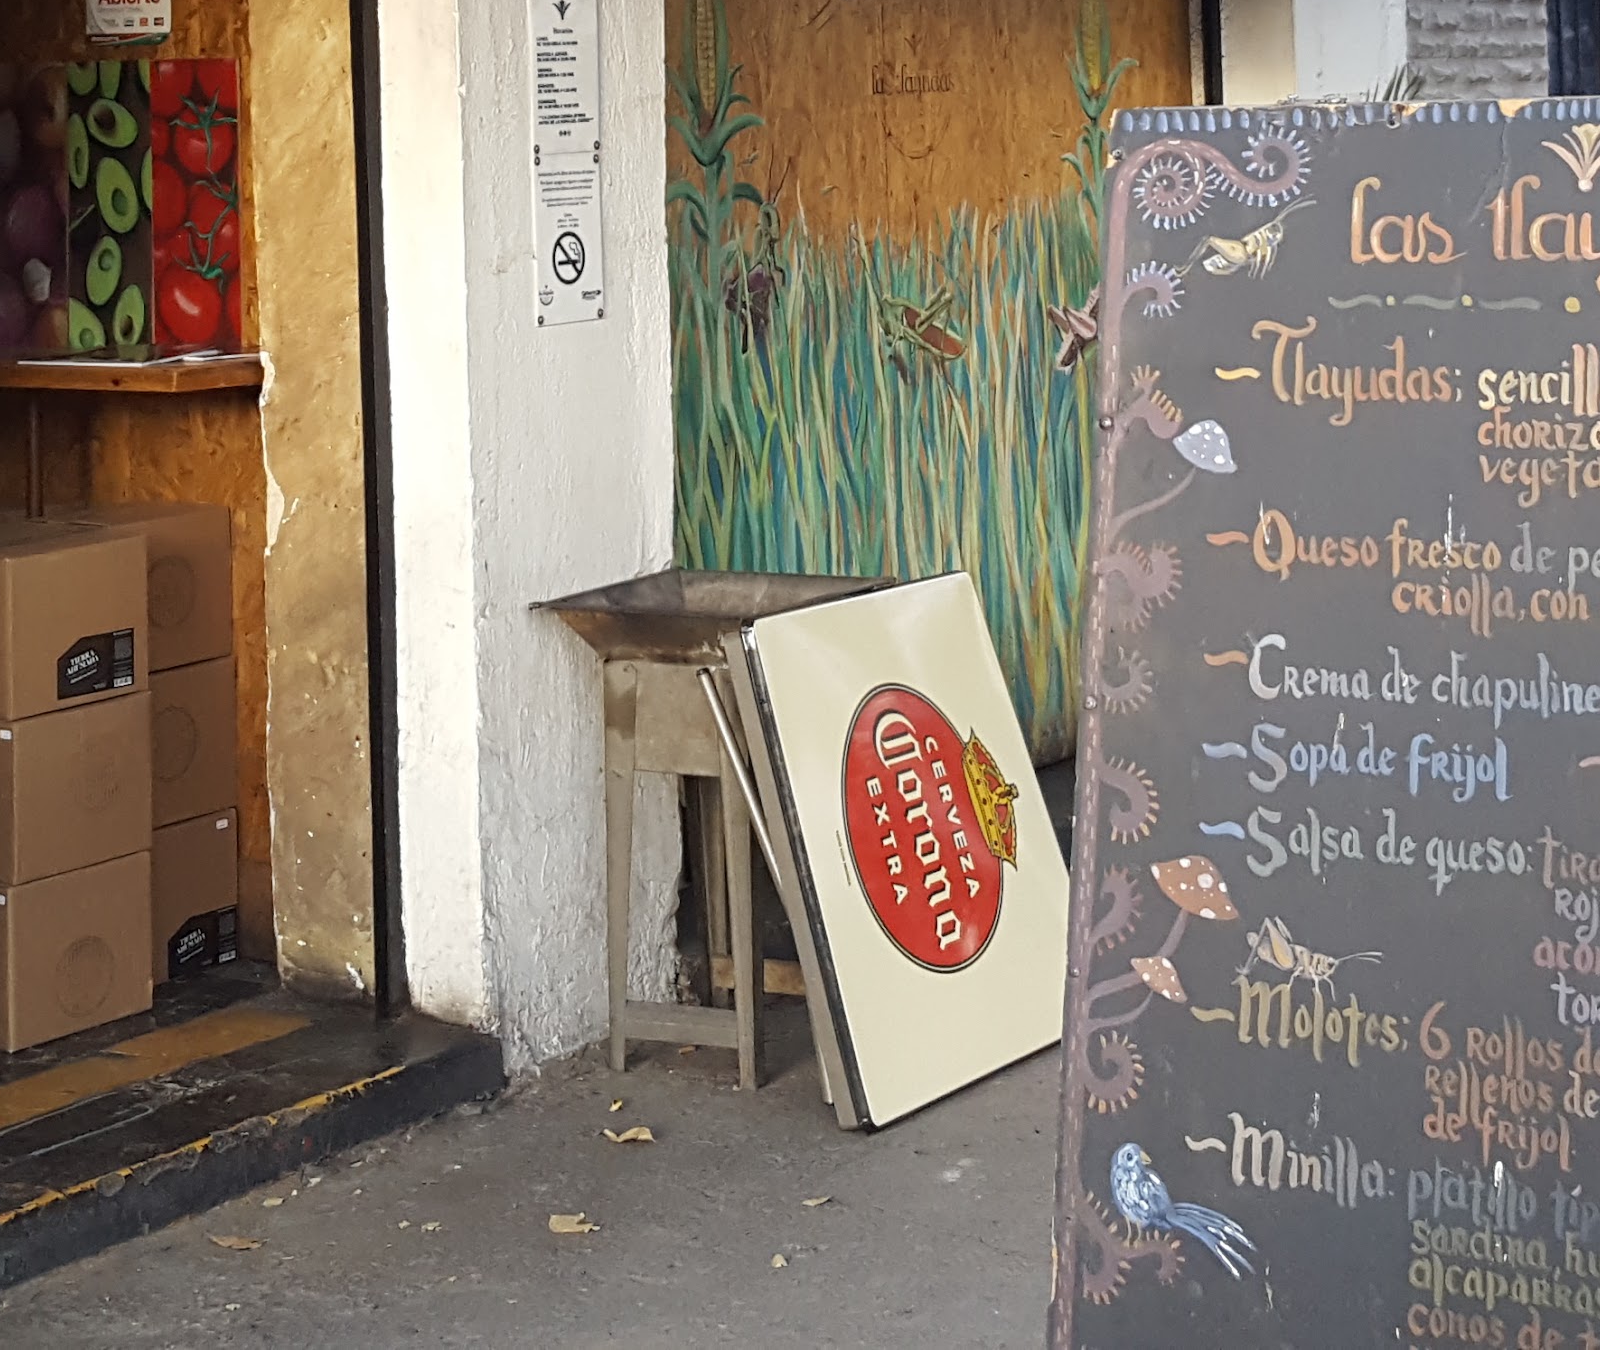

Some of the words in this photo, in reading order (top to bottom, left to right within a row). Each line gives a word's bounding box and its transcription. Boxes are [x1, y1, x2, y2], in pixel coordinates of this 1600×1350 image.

[1350, 175, 1468, 264] las
[1253, 508, 1379, 581] Queso
[1387, 518, 1501, 578] fresco
[1510, 521, 1556, 574] de
[1531, 587, 1590, 621] con
[1249, 633, 1372, 700] Crema
[1382, 646, 1422, 704] de
[1248, 723, 1352, 793] Sopa
[1357, 722, 1397, 776] de
[1409, 732, 1512, 802] frijol
[866, 776, 908, 905] EXTRA
[874, 709, 961, 950] Corona
[926, 736, 981, 898] CERVEZA
[1246, 806, 1363, 877] Salsa
[1376, 808, 1416, 866] de
[1419, 1001, 1451, 1060] 6
[1467, 1013, 1564, 1079] rollos
[1423, 1095, 1461, 1142] de
[1564, 1070, 1600, 1118] de
[1408, 1156, 1537, 1231] platillo
